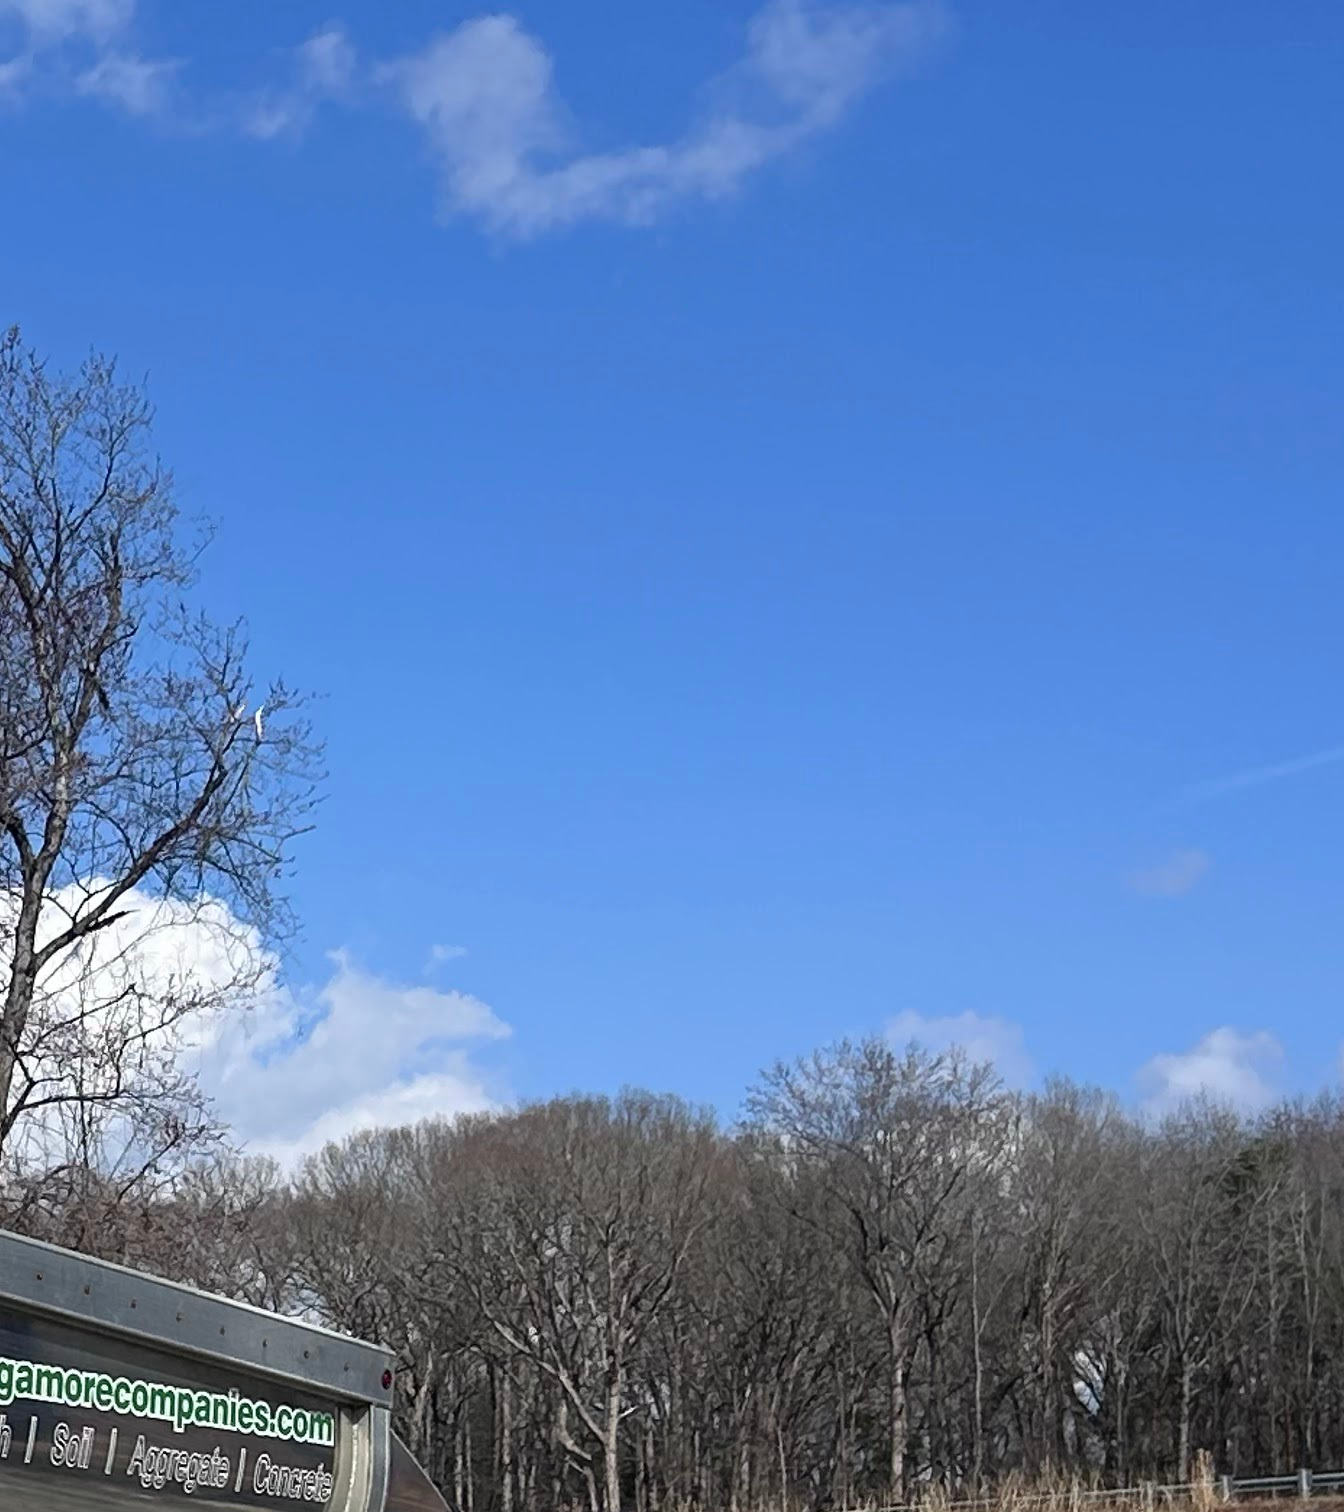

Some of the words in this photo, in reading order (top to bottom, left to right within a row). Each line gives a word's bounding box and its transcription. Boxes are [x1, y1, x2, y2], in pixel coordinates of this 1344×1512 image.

[50, 1422, 95, 1470] Soil
[126, 1434, 230, 1494] Aggregate
[253, 1453, 333, 1503] Concrete
